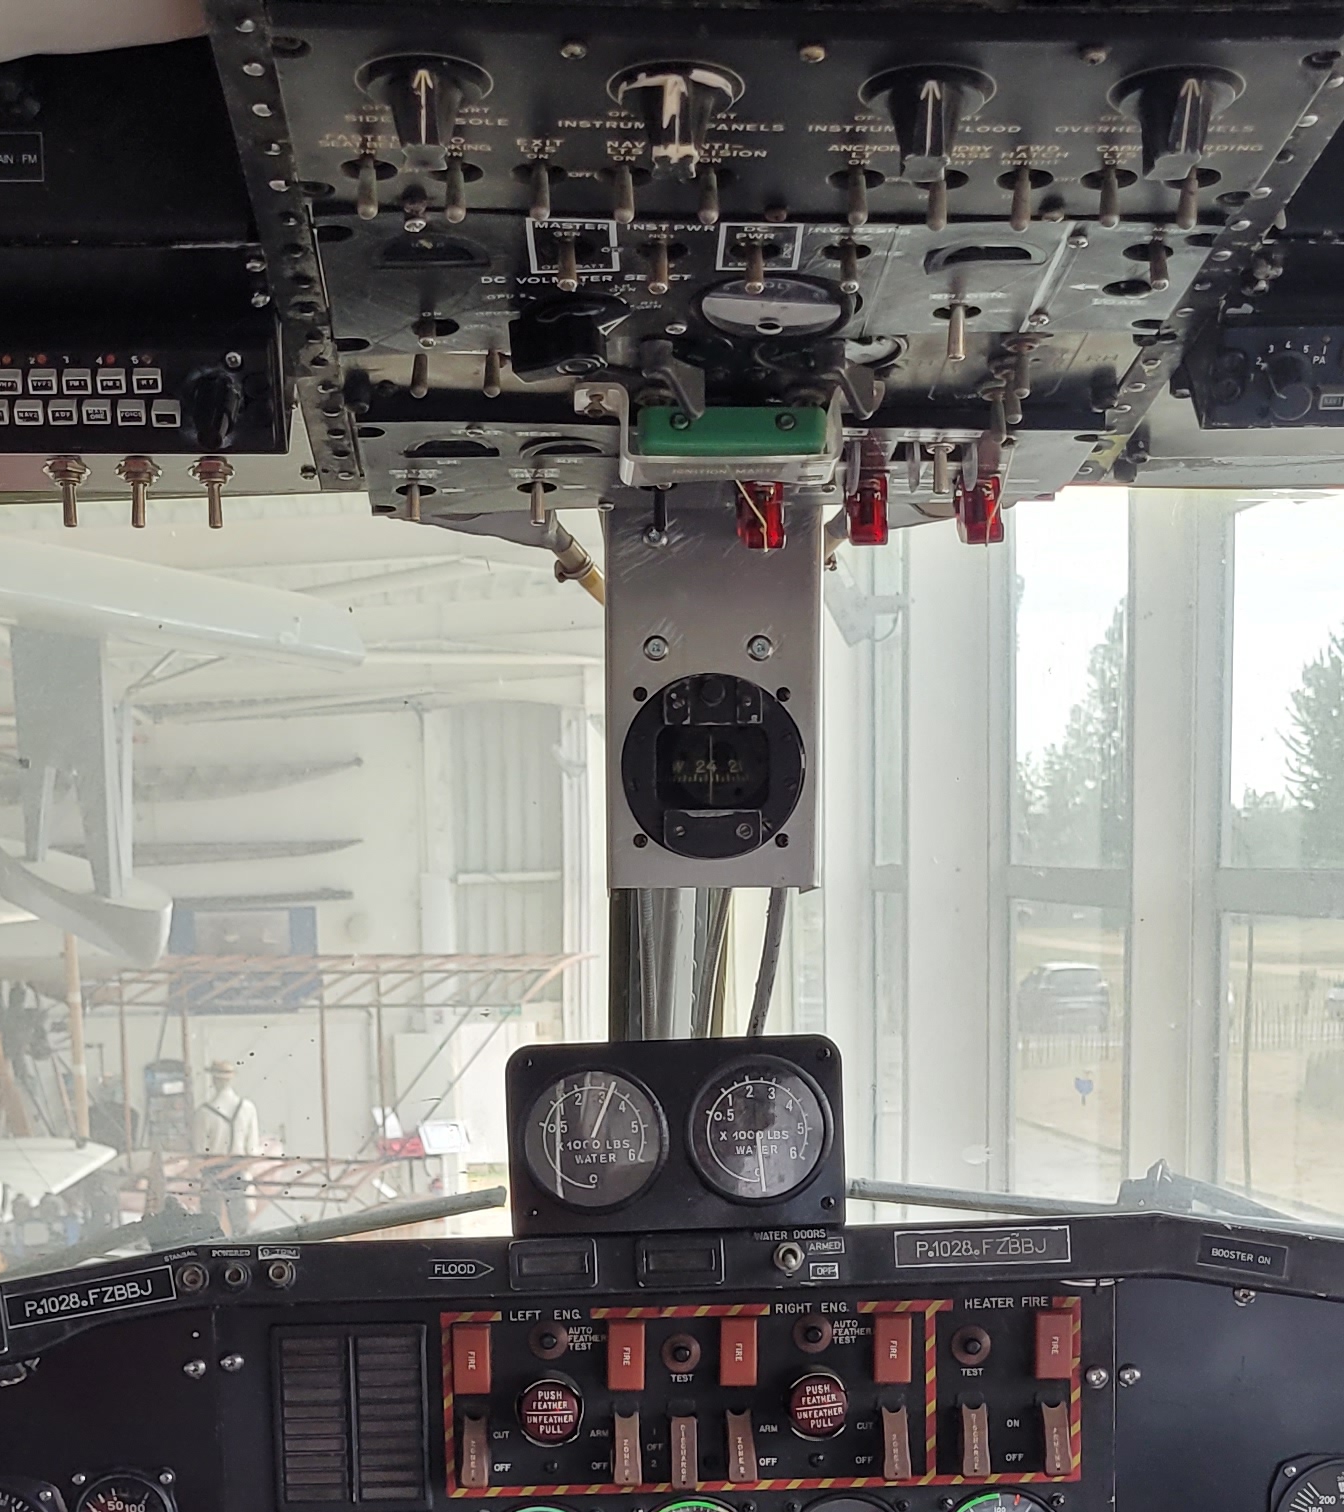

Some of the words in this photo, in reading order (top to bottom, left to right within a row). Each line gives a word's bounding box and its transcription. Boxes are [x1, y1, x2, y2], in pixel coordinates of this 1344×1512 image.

[516, 138, 564, 148] EXIT
[606, 140, 647, 149] NAV
[519, 146, 556, 154] LTS
[606, 147, 643, 155] LTS
[22, 154, 37, 164] FM
[1001, 151, 1069, 159] HATCH
[534, 222, 608, 231] MASTER
[626, 224, 669, 232] INST
[673, 224, 715, 233] PWR
[736, 233, 776, 241] PWR
[481, 276, 506, 285] DC
[1313, 355, 1326, 365] PA
[714, 1109, 734, 1122] 0.5
[767, 1130, 789, 1140] LBS
[606, 1140, 630, 1149] LBS
[575, 1154, 616, 1164] WATER
[755, 1231, 788, 1240] WATER
[793, 1229, 826, 1239] DOORS
[808, 1241, 842, 1251] ARMED
[1212, 1248, 1253, 1262] BOOSTER
[1258, 1256, 1271, 1265] ON
[434, 1264, 476, 1275] FLOOD
[965, 1298, 1014, 1309] HEATER
[1022, 1297, 1048, 1307] FIRE
[775, 1303, 812, 1314] RIGHT
[510, 1310, 542, 1321] LEFT
[833, 1320, 858, 1328] AUTO
[833, 1336, 856, 1344] TEST
[568, 1343, 592, 1351] TEST
[889, 1340, 897, 1359] FIRE
[1051, 1336, 1059, 1355] FIRE
[735, 1343, 743, 1362] FIRE
[961, 1368, 983, 1376] TEST
[671, 1374, 694, 1382] TEST
[806, 1384, 831, 1394] PUSH
[538, 1391, 562, 1400] PUSH
[802, 1394, 837, 1405] FEATHER
[533, 1401, 568, 1409] FEATHER
[797, 1407, 843, 1419] UNFEATHER
[527, 1415, 574, 1423] UNFEATHER
[810, 1419, 833, 1428] PULL
[857, 1422, 873, 1430] CUT
[1006, 1420, 1020, 1428] ON
[540, 1425, 563, 1434] PULL
[590, 1429, 608, 1437] ARM
[493, 1431, 509, 1439] CUT
[647, 1443, 663, 1451] OFF
[759, 1458, 777, 1466] OFF
[856, 1456, 873, 1464] OFF
[494, 1464, 511, 1472] OFF
[591, 1462, 608, 1470] OFF
[107, 1501, 124, 1511] 50
